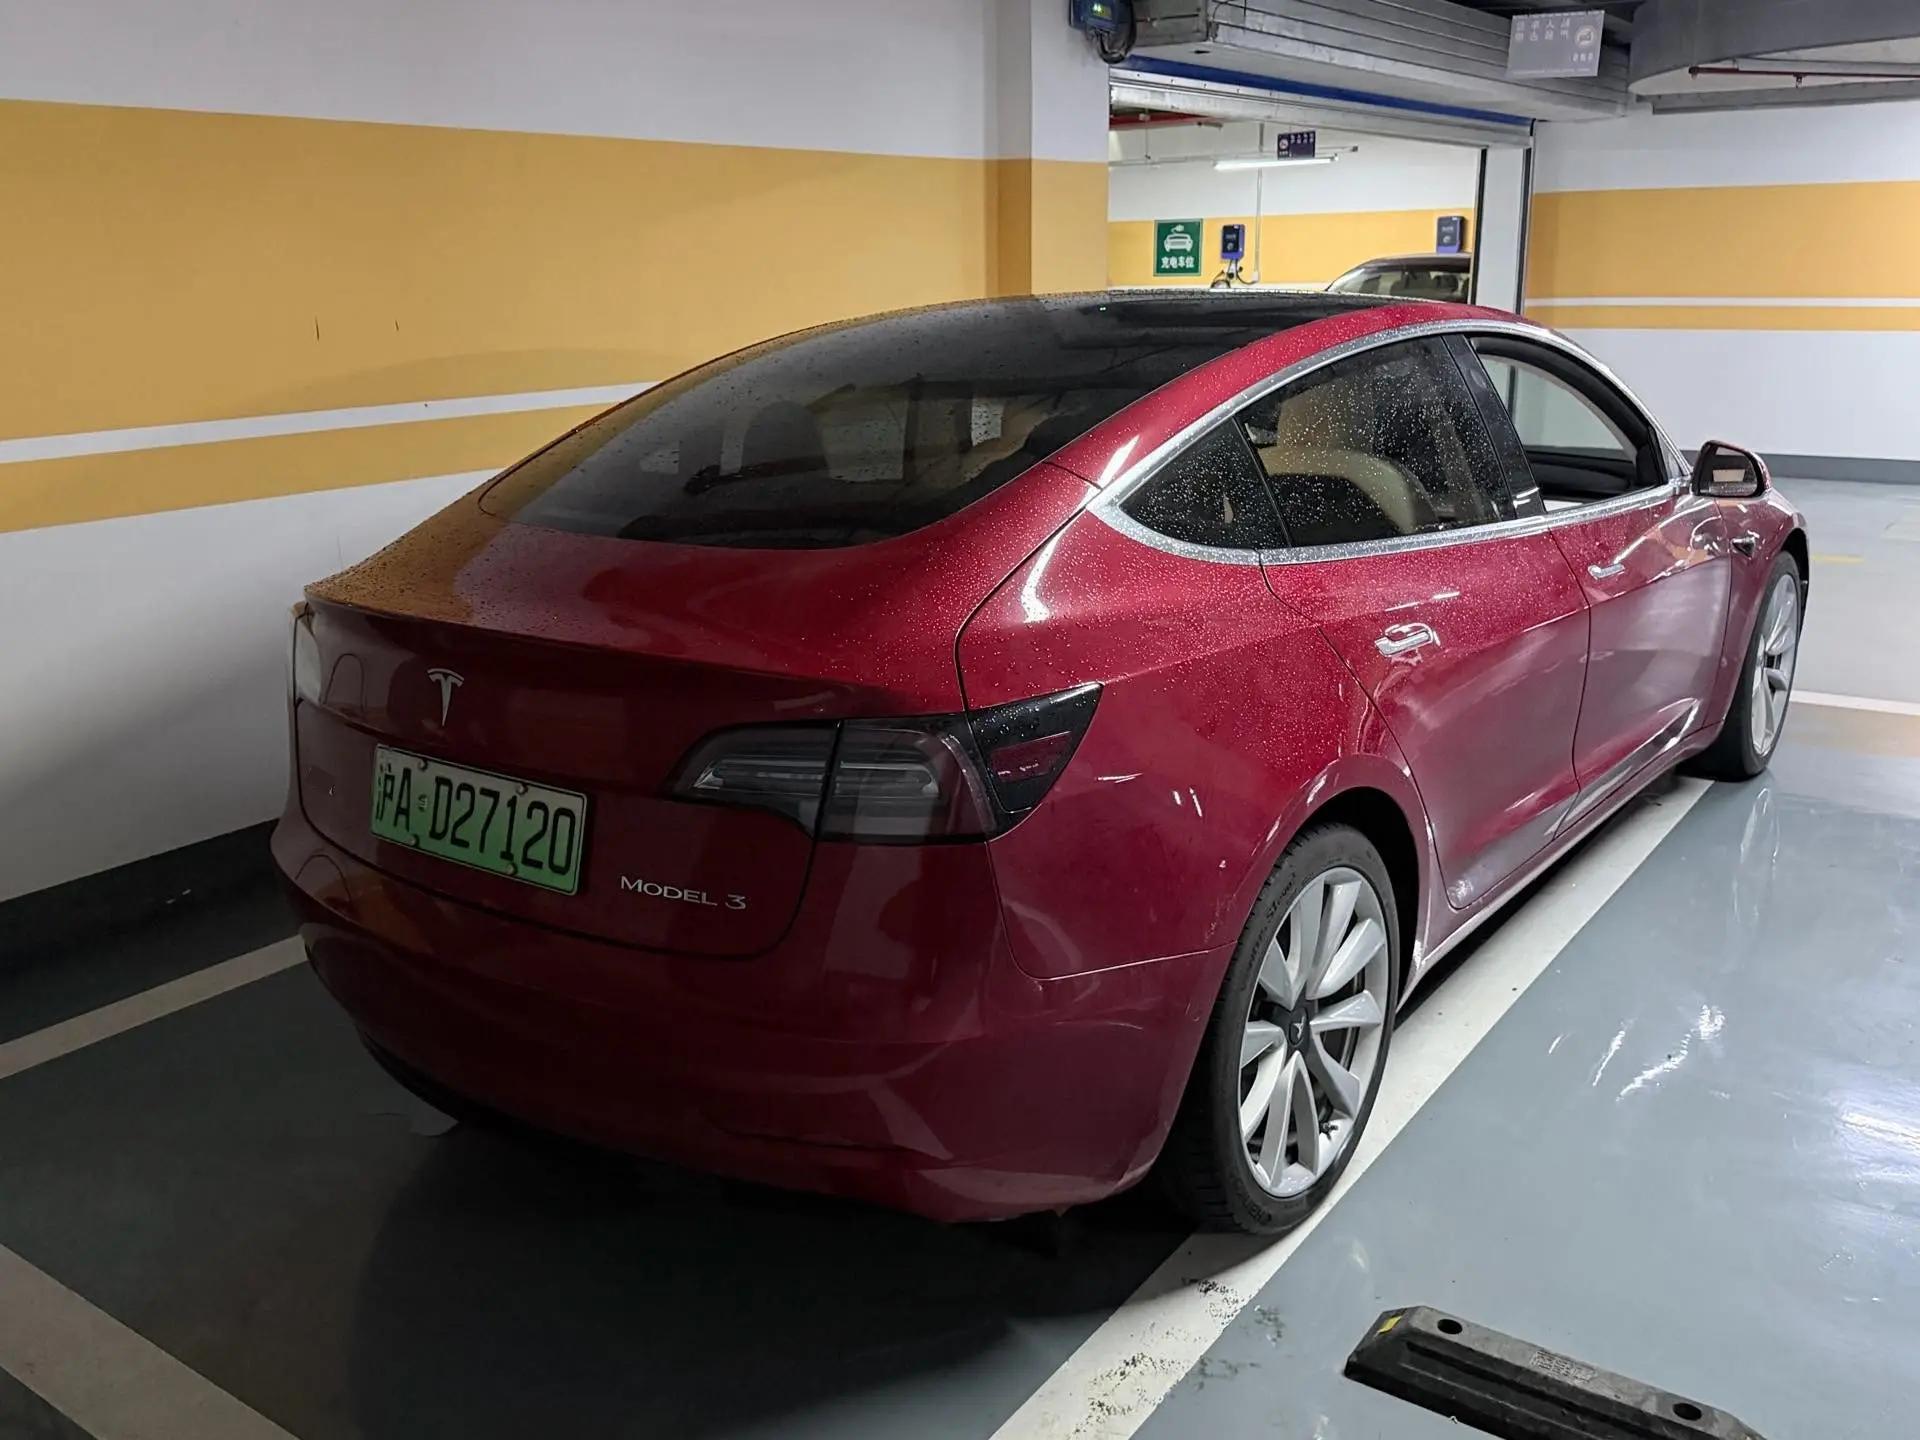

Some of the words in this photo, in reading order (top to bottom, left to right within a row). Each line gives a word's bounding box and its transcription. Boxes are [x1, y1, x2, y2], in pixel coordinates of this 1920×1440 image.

[1161, 256, 1195, 269] 充电车位
[620, 875, 718, 906] MODEL
[725, 893, 747, 910] 3
